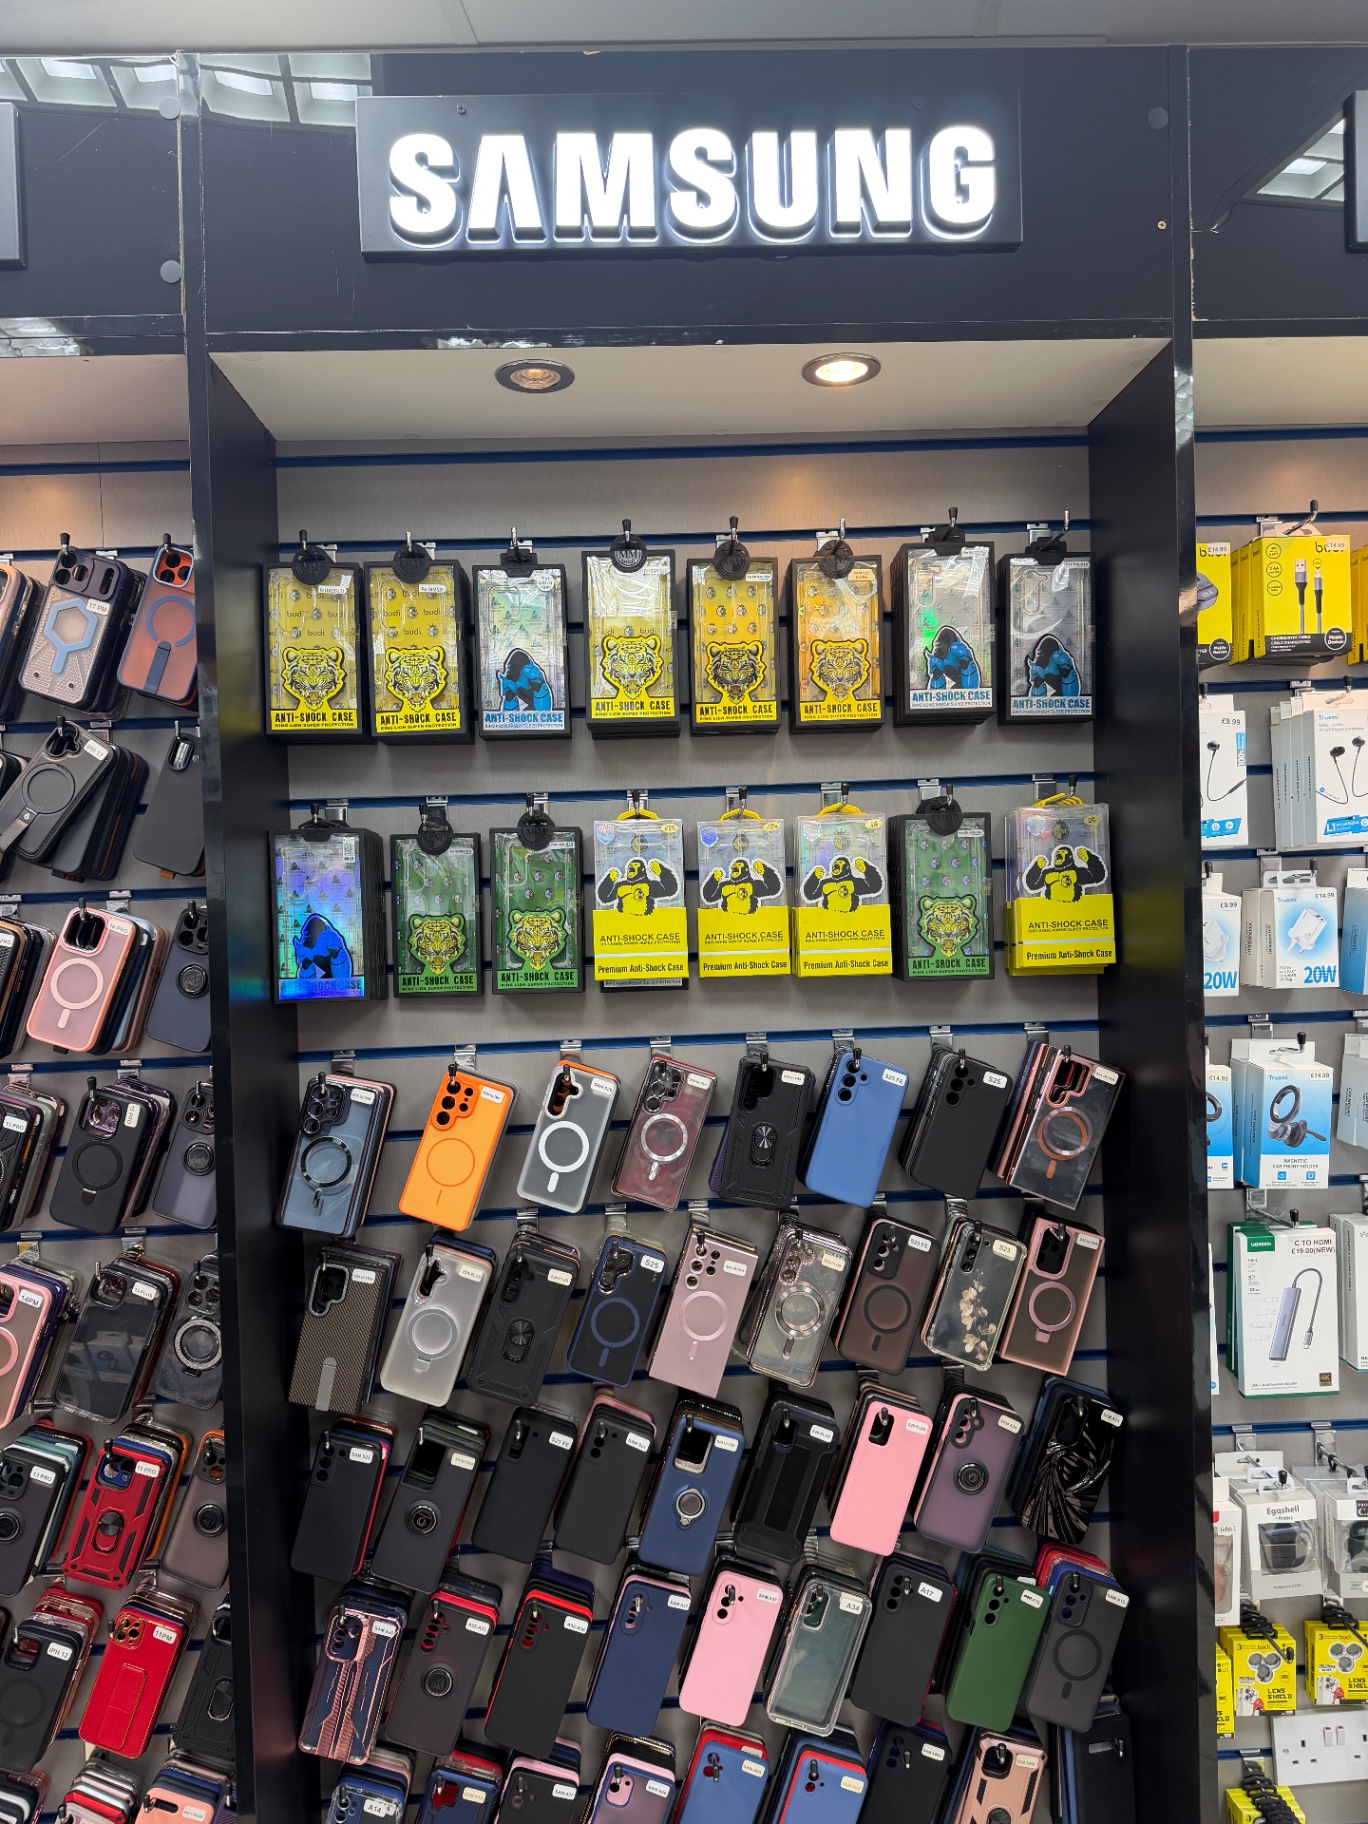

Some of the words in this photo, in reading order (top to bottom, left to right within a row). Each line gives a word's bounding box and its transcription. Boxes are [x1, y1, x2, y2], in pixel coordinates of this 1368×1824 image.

[389, 127, 997, 247] SAMSUNG
[384, 609, 400, 617] budi
[912, 692, 966, 702] ANTI-SHOCK
[968, 691, 990, 700] CASE
[596, 700, 644, 712] ANTI-SHOCK
[650, 700, 670, 710] CASE
[804, 703, 852, 714] ANTI-SHOCK
[856, 702, 878, 712] CASE
[1012, 699, 1066, 709] ANTI-SHOCK
[1068, 699, 1090, 708] CASE
[700, 704, 748, 716] ANTI-SHOCK
[752, 703, 774, 714] CASE
[275, 712, 327, 722] ANTI-SHOCK
[332, 712, 354, 722] CASE
[380, 712, 430, 724] ANTI-SHOCK
[436, 711, 456, 722] CASE
[485, 713, 538, 723] ANTI-SHOCK
[540, 713, 563, 722] CASE
[1327, 822, 1336, 832] L1
[116, 925, 128, 933] PRO
[1028, 920, 1082, 929] ANTI-SHOCK
[656, 933, 680, 941] CASE
[705, 932, 758, 940] ANTI-SHOCK
[760, 931, 783, 939] CASE
[805, 931, 859, 939] ANTI-SHOCK
[862, 930, 885, 938] CASE
[1027, 952, 1057, 960] Premium
[1058, 951, 1094, 960] Anti-Shock
[598, 964, 628, 974] Premium
[630, 963, 666, 972] Anti-Shock
[668, 962, 684, 971] Case
[703, 962, 732, 971] Premium
[734, 961, 769, 970] Anti-Shock
[771, 961, 788, 969] Case
[804, 961, 833, 970] Premium
[835, 960, 870, 969] Anti-Shock
[872, 960, 889, 968] Case
[912, 959, 961, 970] ANTI-SHOCK
[965, 958, 986, 968] CASE
[501, 972, 550, 982] ANTI-SHOCK
[554, 971, 574, 981] CASE
[1304, 965, 1337, 983] 20W
[402, 976, 449, 986] ANTI-SHOCK
[454, 975, 474, 984] CASE
[1204, 972, 1237, 989] 20W
[896, 1076, 904, 1084] FE
[988, 1076, 1001, 1085] S25
[999, 1244, 1011, 1253] S23
[1291, 1247, 1335, 1255] £19.00(NEW)
[645, 1259, 658, 1269] S25
[21, 1295, 39, 1306] 14PM
[1266, 1505, 1299, 1516] Eggshell
[920, 1587, 934, 1596] A17
[845, 1603, 860, 1611] A34
[155, 1630, 172, 1641] 11PM
[368, 1805, 382, 1814] A14
